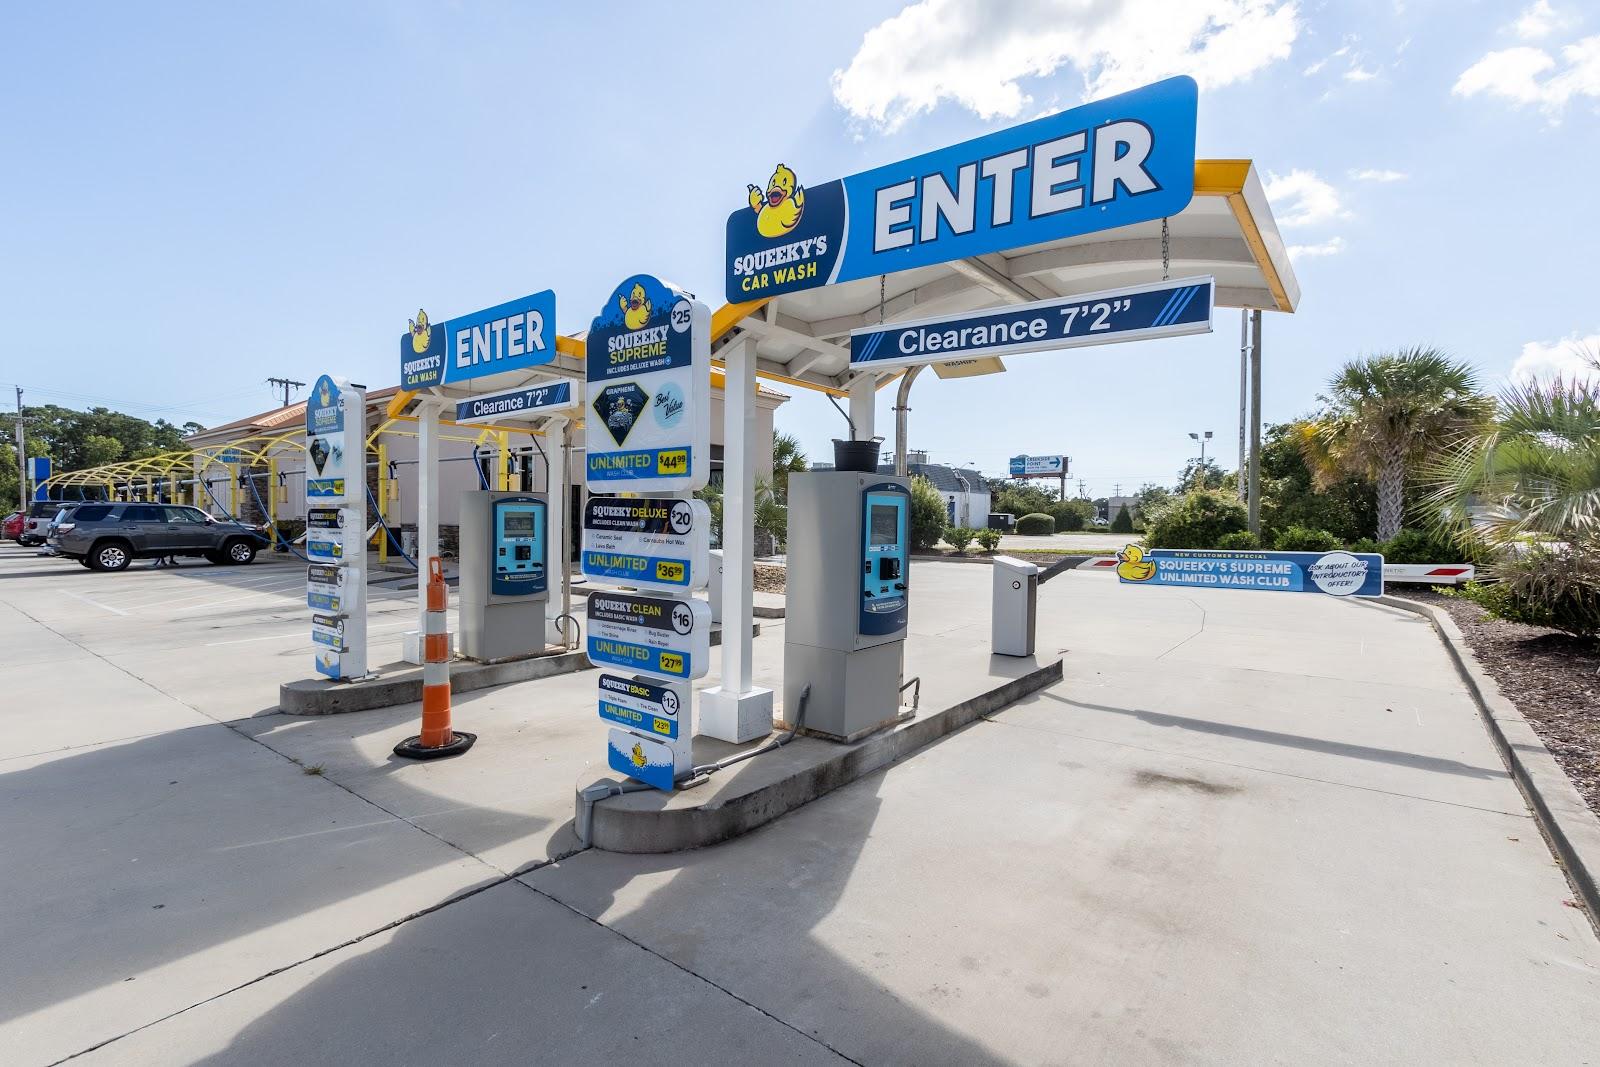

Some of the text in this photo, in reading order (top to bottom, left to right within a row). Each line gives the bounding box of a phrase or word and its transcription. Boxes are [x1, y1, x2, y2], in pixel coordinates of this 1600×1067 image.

[874, 119, 1161, 254] ENTER
[733, 235, 828, 276] SQUEEKY'S
[742, 261, 817, 292] CAR WASH
[672, 309, 691, 325] $25
[456, 309, 547, 369] ENTER
[608, 324, 670, 353] SQUEEKY
[898, 318, 1047, 354] Clearance
[610, 341, 667, 365] SUPREME
[403, 355, 440, 375] SQUEEKY'S
[606, 358, 665, 375] INCLUDES DELUXE WASH
[407, 370, 437, 385] CAR WASH
[606, 385, 635, 395] GRAPHENE
[473, 396, 523, 416] Clearance
[654, 391, 671, 407] Best
[663, 399, 684, 417] Value
[590, 454, 651, 470] UNLIMITED
[592, 505, 668, 519] SQUEEKY DELUXE
[671, 510, 690, 526] $20
[589, 553, 648, 571] UNLIMITED
[1159, 560, 1292, 575] SQUEEKY'S SUPREME
[1324, 562, 1348, 570] ABOUT
[1160, 572, 1290, 587] UNLIMITED WASH CLUB
[1312, 570, 1367, 580] INTRODUCTORY
[1327, 580, 1353, 588] OFFER!
[594, 598, 661, 617] SQUEEKY CLEAN
[594, 611, 614, 619] INCLUDES
[673, 611, 690, 627] $16
[596, 640, 650, 660] UNLIMITED
[602, 678, 650, 697] SQUEEKY BASIC
[663, 695, 676, 709] $12
[605, 703, 642, 722] UNLIMITED
